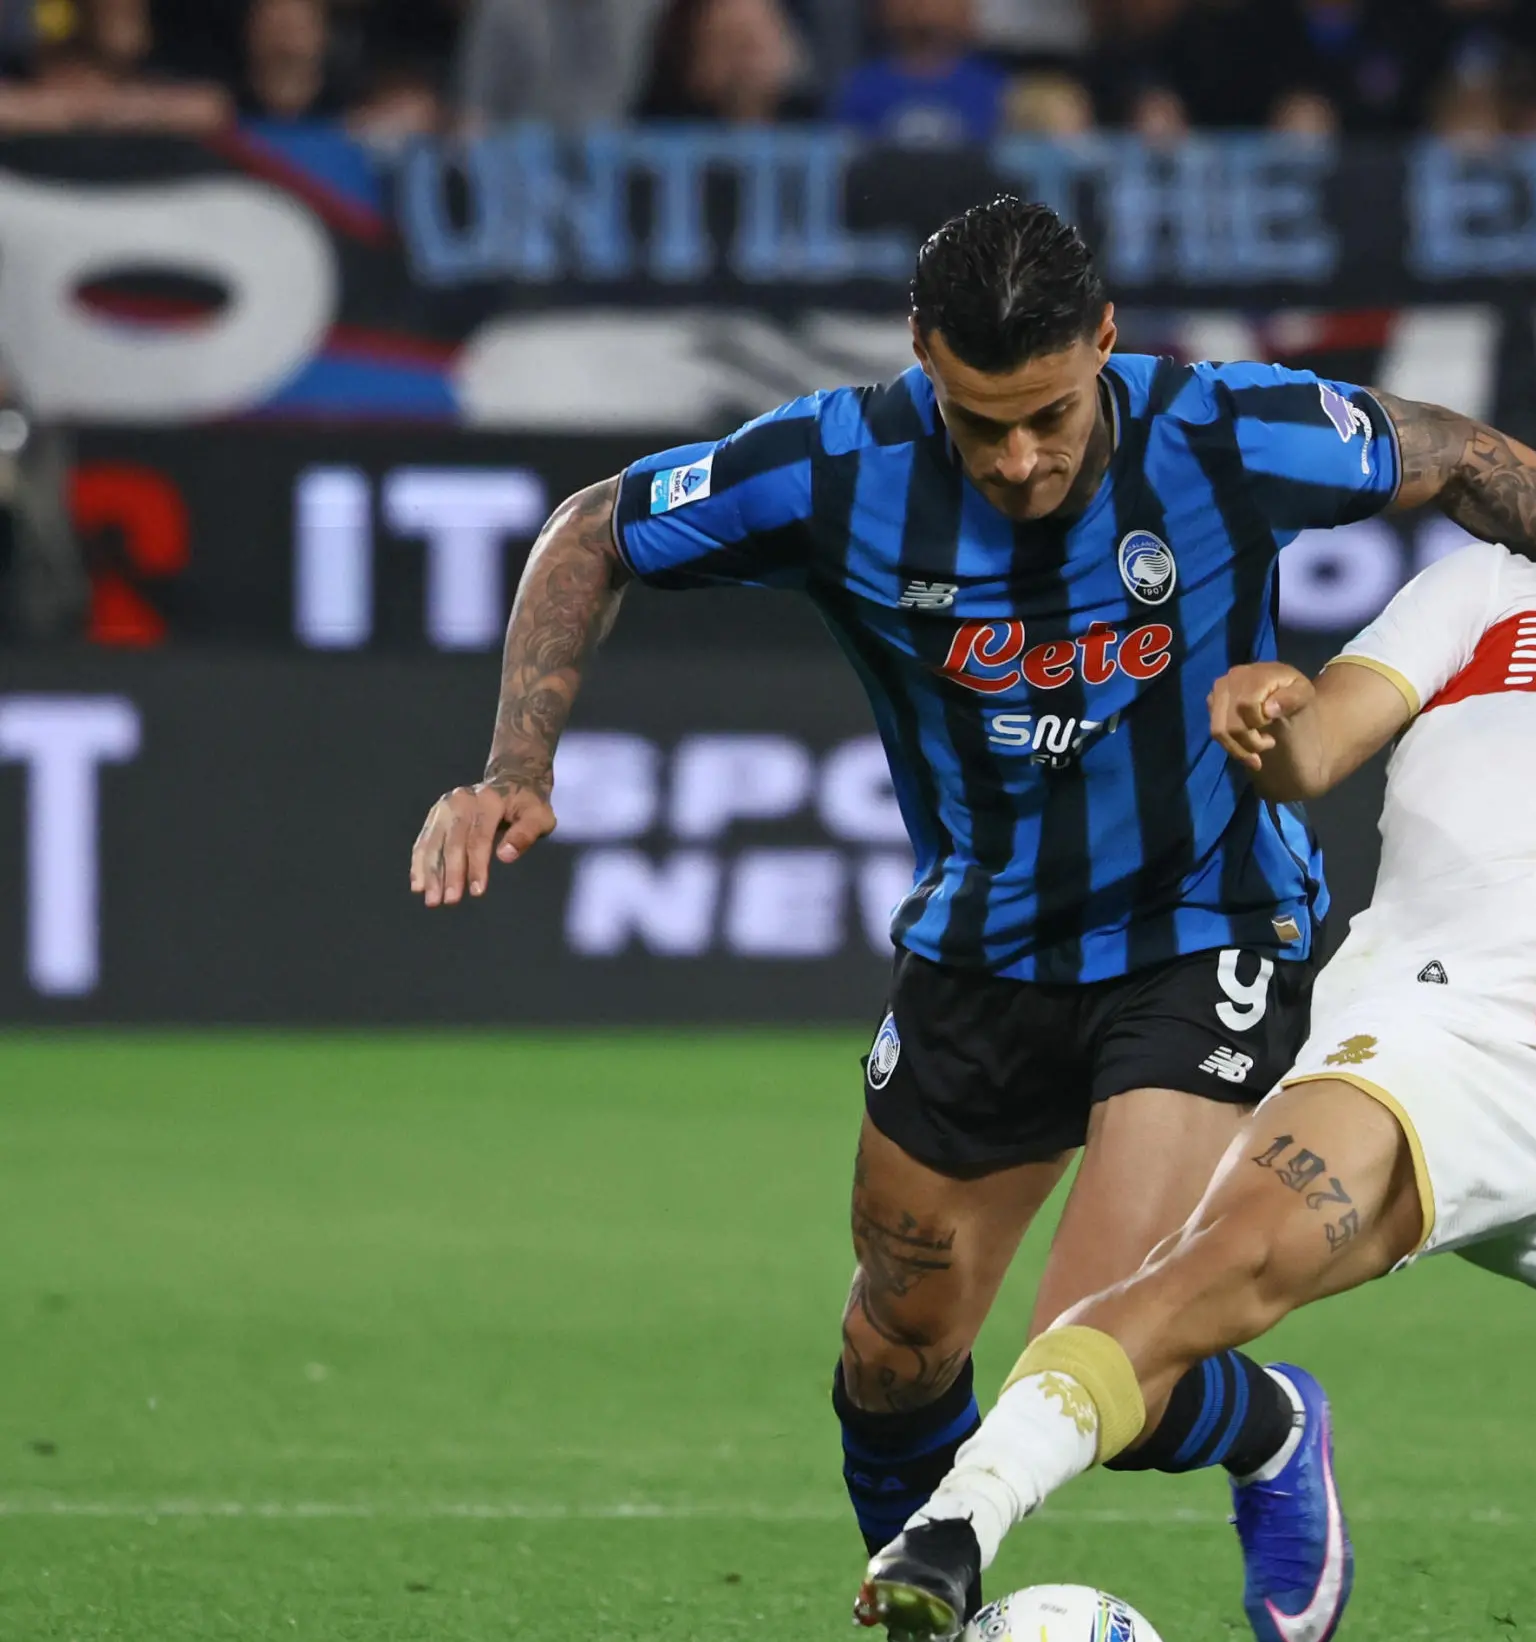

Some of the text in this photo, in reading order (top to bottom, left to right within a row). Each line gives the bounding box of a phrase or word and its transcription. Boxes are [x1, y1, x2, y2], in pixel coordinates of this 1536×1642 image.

[405, 124, 913, 284] UNTIL
[1143, 585, 1164, 596] 1907
[936, 618, 1173, 694] Lete
[550, 729, 912, 842] SPO
[1215, 948, 1274, 1031] 9
